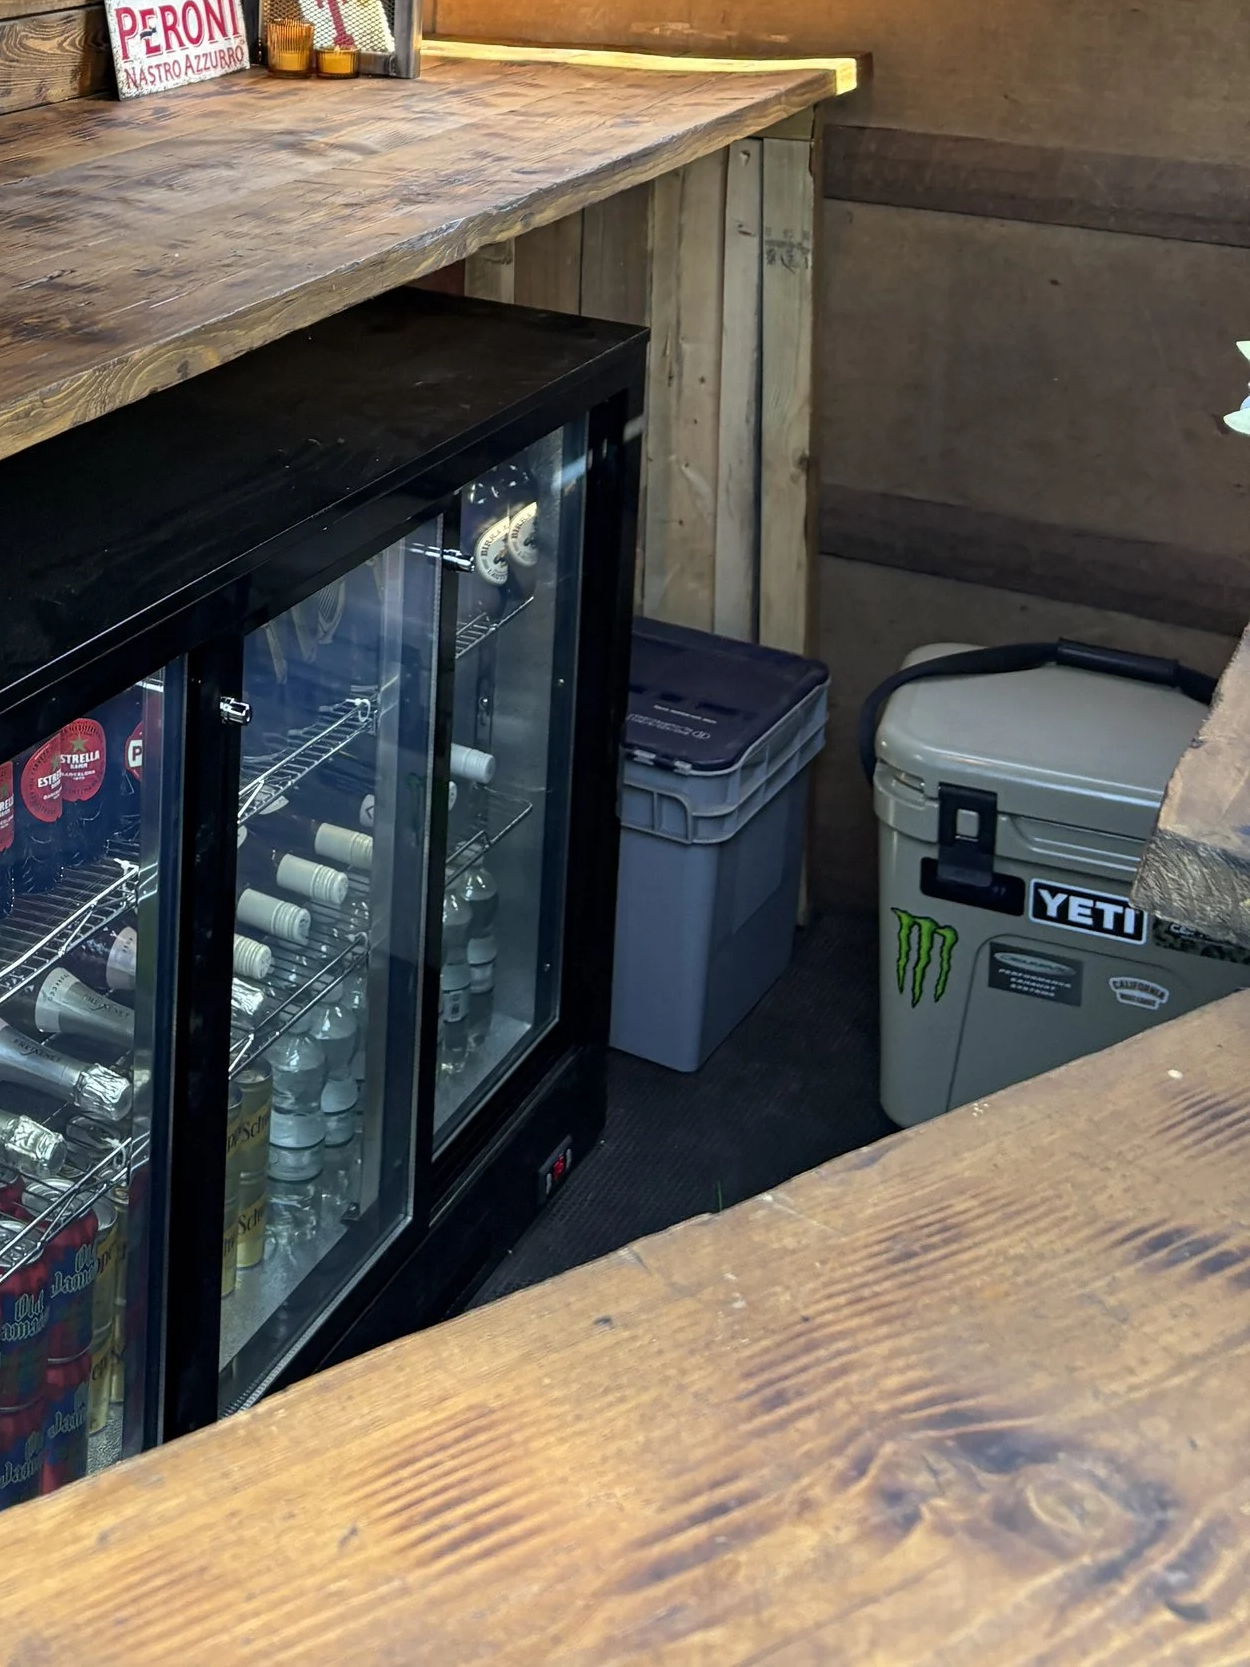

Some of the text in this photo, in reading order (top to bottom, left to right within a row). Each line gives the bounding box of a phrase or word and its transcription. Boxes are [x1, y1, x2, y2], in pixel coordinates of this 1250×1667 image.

[124, 45, 245, 90] NASTRO AZZURRO
[60, 750, 100, 764] STRELLA
[1038, 888, 1136, 935] YETI
